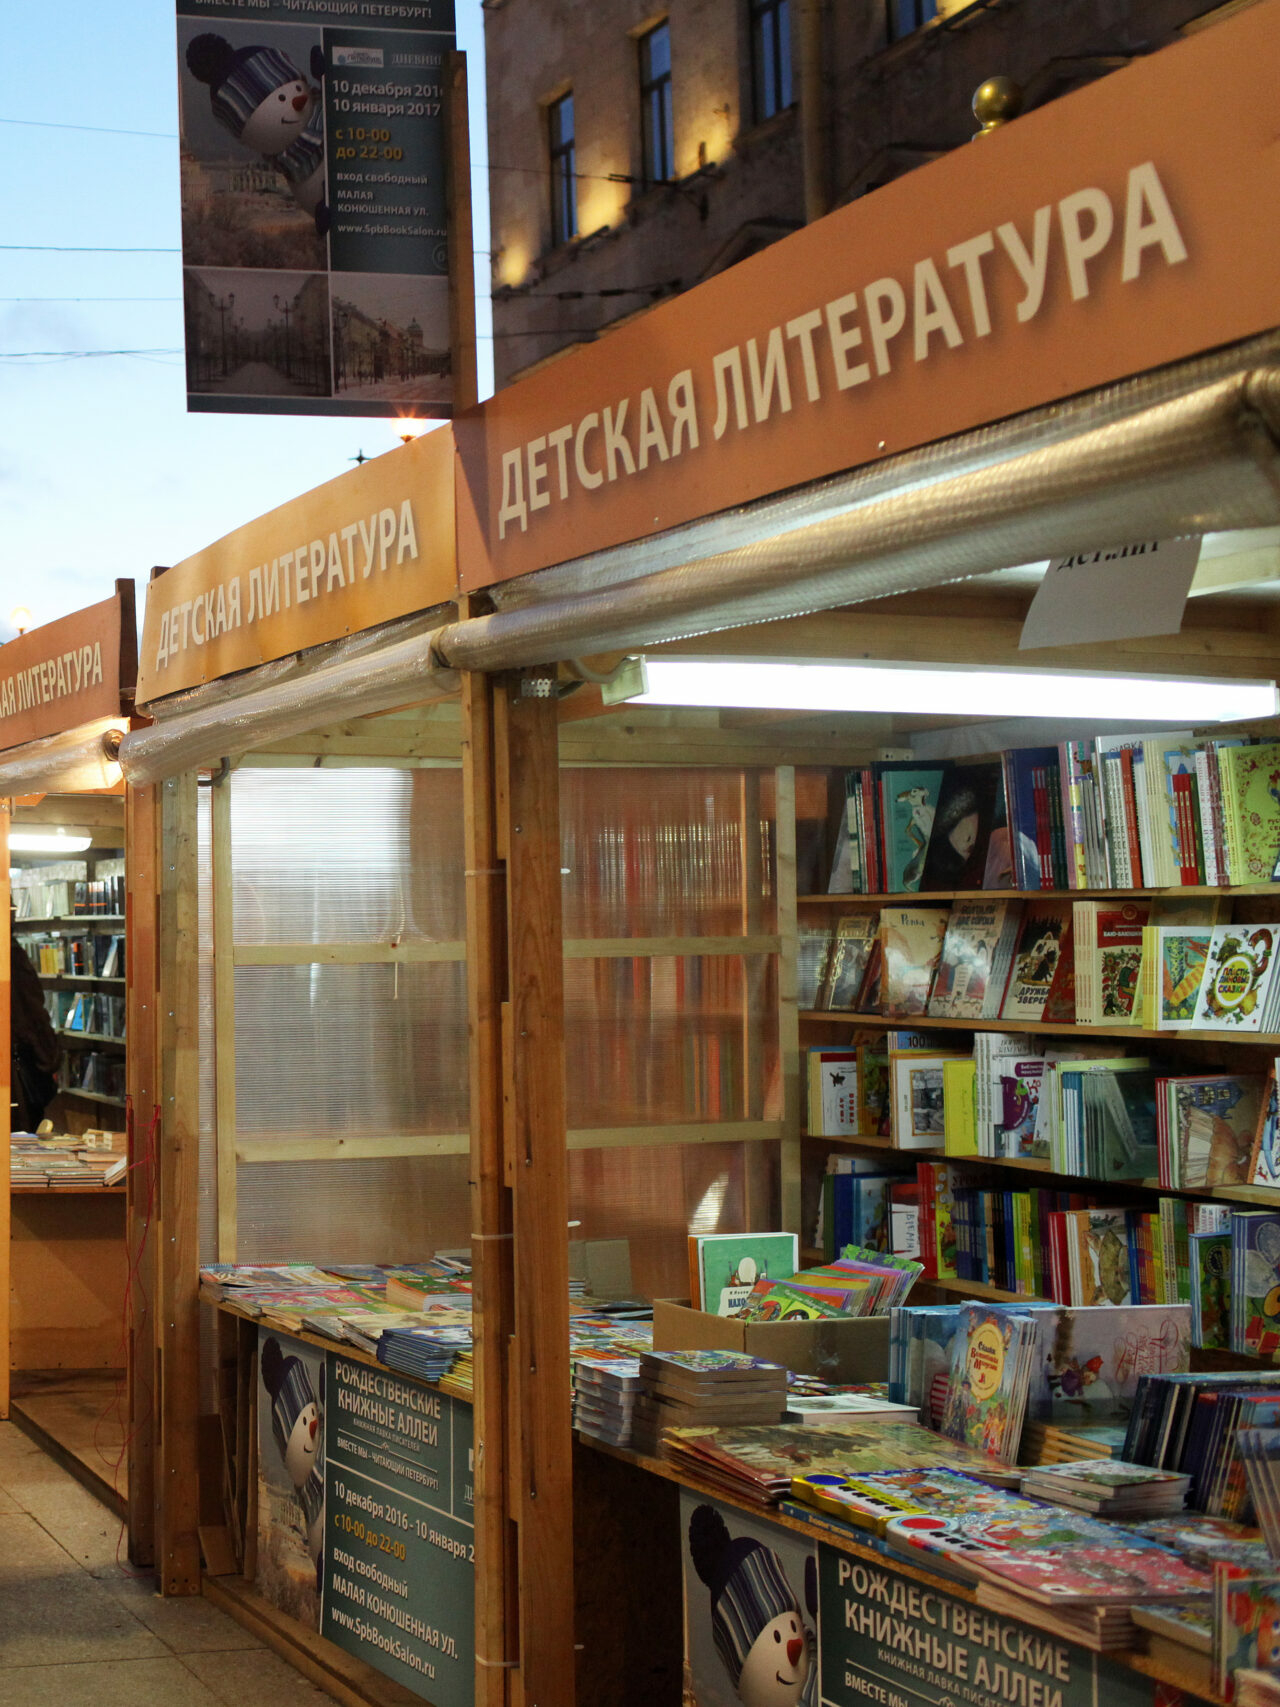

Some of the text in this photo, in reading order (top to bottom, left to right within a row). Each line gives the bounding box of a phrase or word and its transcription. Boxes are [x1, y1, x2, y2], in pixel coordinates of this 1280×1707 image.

[361, 4, 432, 18] ПЕТЕРБУРГ!
[392, 54, 441, 65] ДНЕВНИ
[332, 80, 350, 93] 10
[352, 82, 412, 98] декабря
[333, 98, 440, 117] 10 января 2017
[336, 128, 390, 141] с 10-00
[336, 146, 402, 160] до 22-00
[336, 172, 428, 185] вход свободный
[338, 190, 374, 200] МАЛАЯ
[338, 204, 411, 216] КОНЮШЕННАЯ
[497, 161, 1188, 541] ДЕТСКАЯ ЛИТЕРАТУРА
[156, 499, 418, 672] ДЕТСКАЯ ЛИТЕРАТУРА
[18, 642, 103, 712] ЛИТЕРАТУРА
[1218, 984, 1246, 993] СКАЗКИ
[728, 1298, 748, 1308] НАХО
[336, 1360, 441, 1420] РОЖДЕСТВЕНСКИЕ
[338, 1388, 438, 1447] КНИЖНЫЕ АЛЛЕИ
[337, 1436, 358, 1453] ВМЕСТЕ
[358, 1445, 368, 1459] МЫ
[372, 1451, 405, 1476] ЧИТАЮЩИЙ
[405, 1466, 440, 1491] ПЕТЕРБУРГ!
[334, 1481, 345, 1499] 10
[346, 1489, 384, 1520] декабря
[385, 1504, 408, 1531] 2016
[415, 1519, 428, 1540] 10
[428, 1529, 466, 1560] января
[334, 1514, 407, 1562] с 10-00 до 22-00
[333, 1547, 408, 1599] вход свободный
[332, 1573, 458, 1660] МАЛАЯ КОНЮШЕННАЯ УЛ.
[838, 1558, 1071, 1683] РОЖДЕСТВЕНСКИЕ
[332, 1606, 436, 1680] www.SpbBookSalon.ru
[844, 1598, 1063, 1707] КНИЖНЫЕ АЛЛЕИ
[844, 1671, 909, 1707] ВМЕСТЕ МЫ
[878, 1648, 1008, 1707] КНИЖНАЯ ЛАВКА ПИСАТЕ
